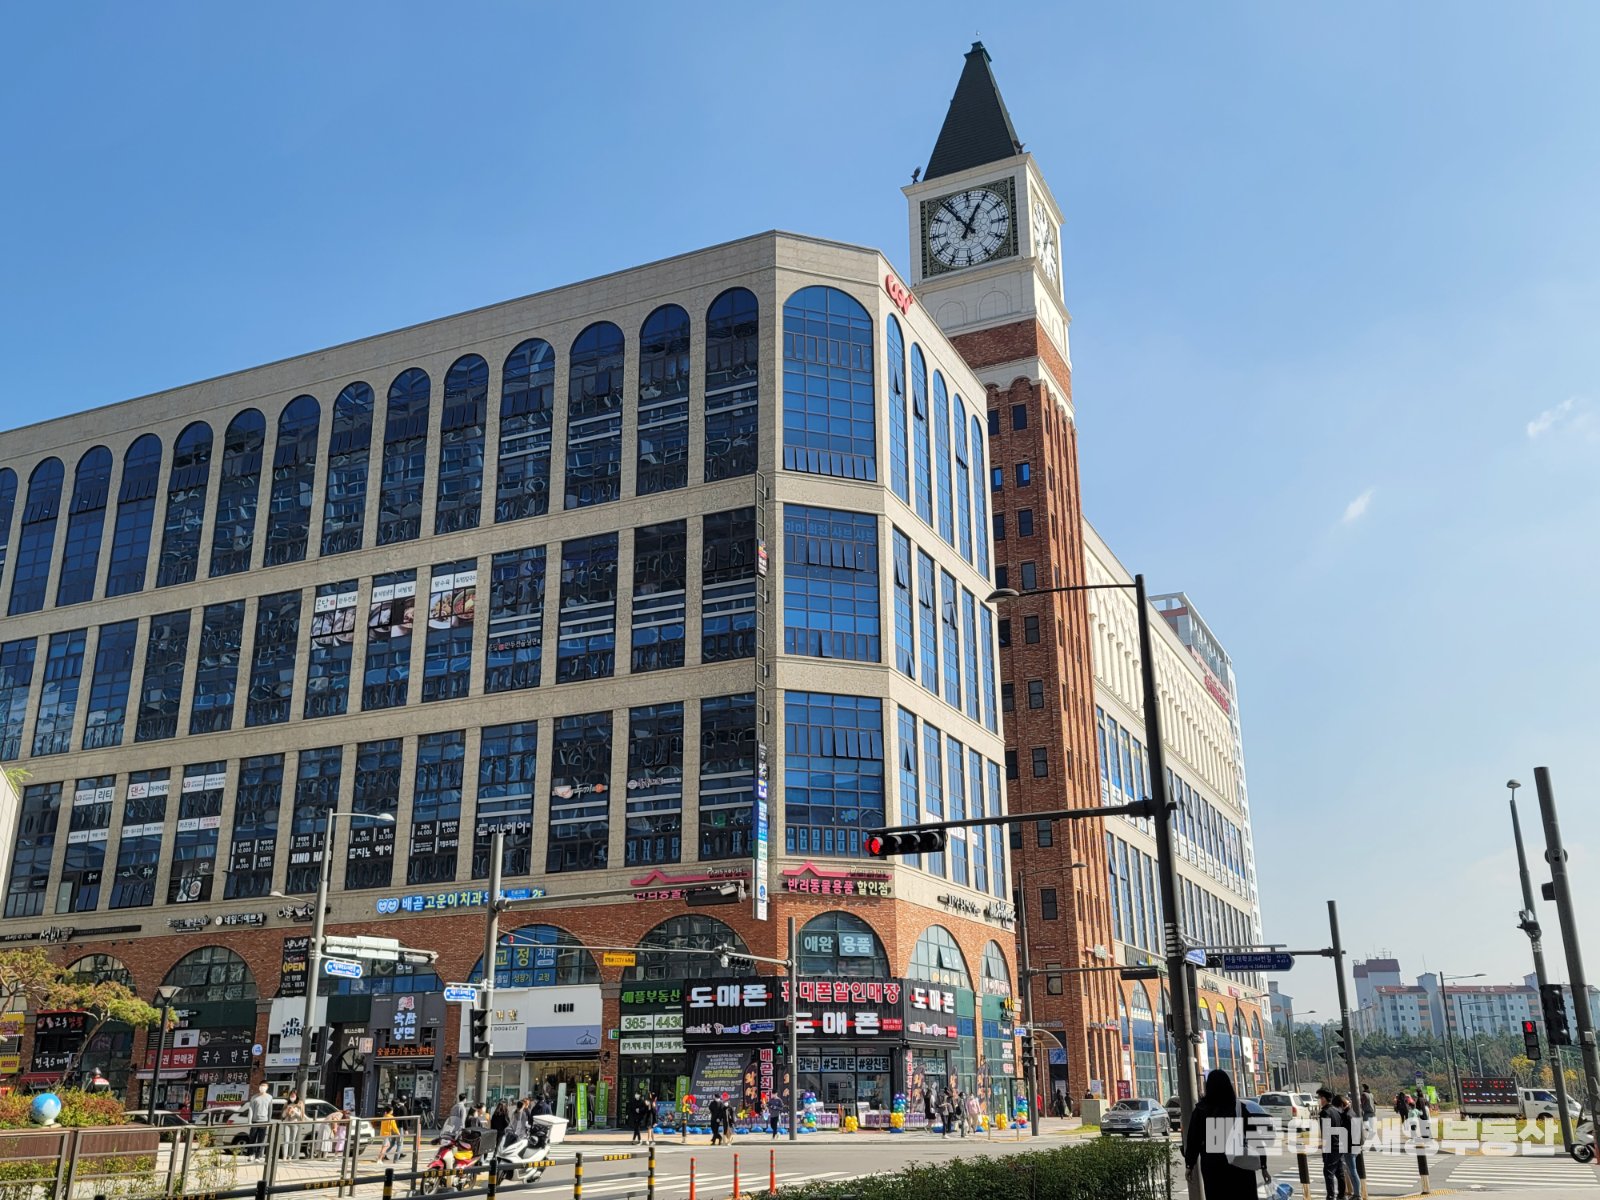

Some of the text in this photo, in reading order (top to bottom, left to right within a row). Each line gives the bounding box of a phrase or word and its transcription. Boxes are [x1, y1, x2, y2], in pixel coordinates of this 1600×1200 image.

[787, 878, 890, 896] 반려동물용품 할인점
[803, 935, 872, 953] 애완 용품
[537, 947, 555, 959] 치과
[283, 961, 306, 974] OPEN
[689, 984, 768, 1008] 도매폰
[912, 986, 955, 1014] 도매폰
[394, 1026, 416, 1040] 냉면
[202, 1050, 249, 1064] 국수 만두
[823, 1057, 856, 1071] #도매폰
[858, 1057, 889, 1071] #왕친절
